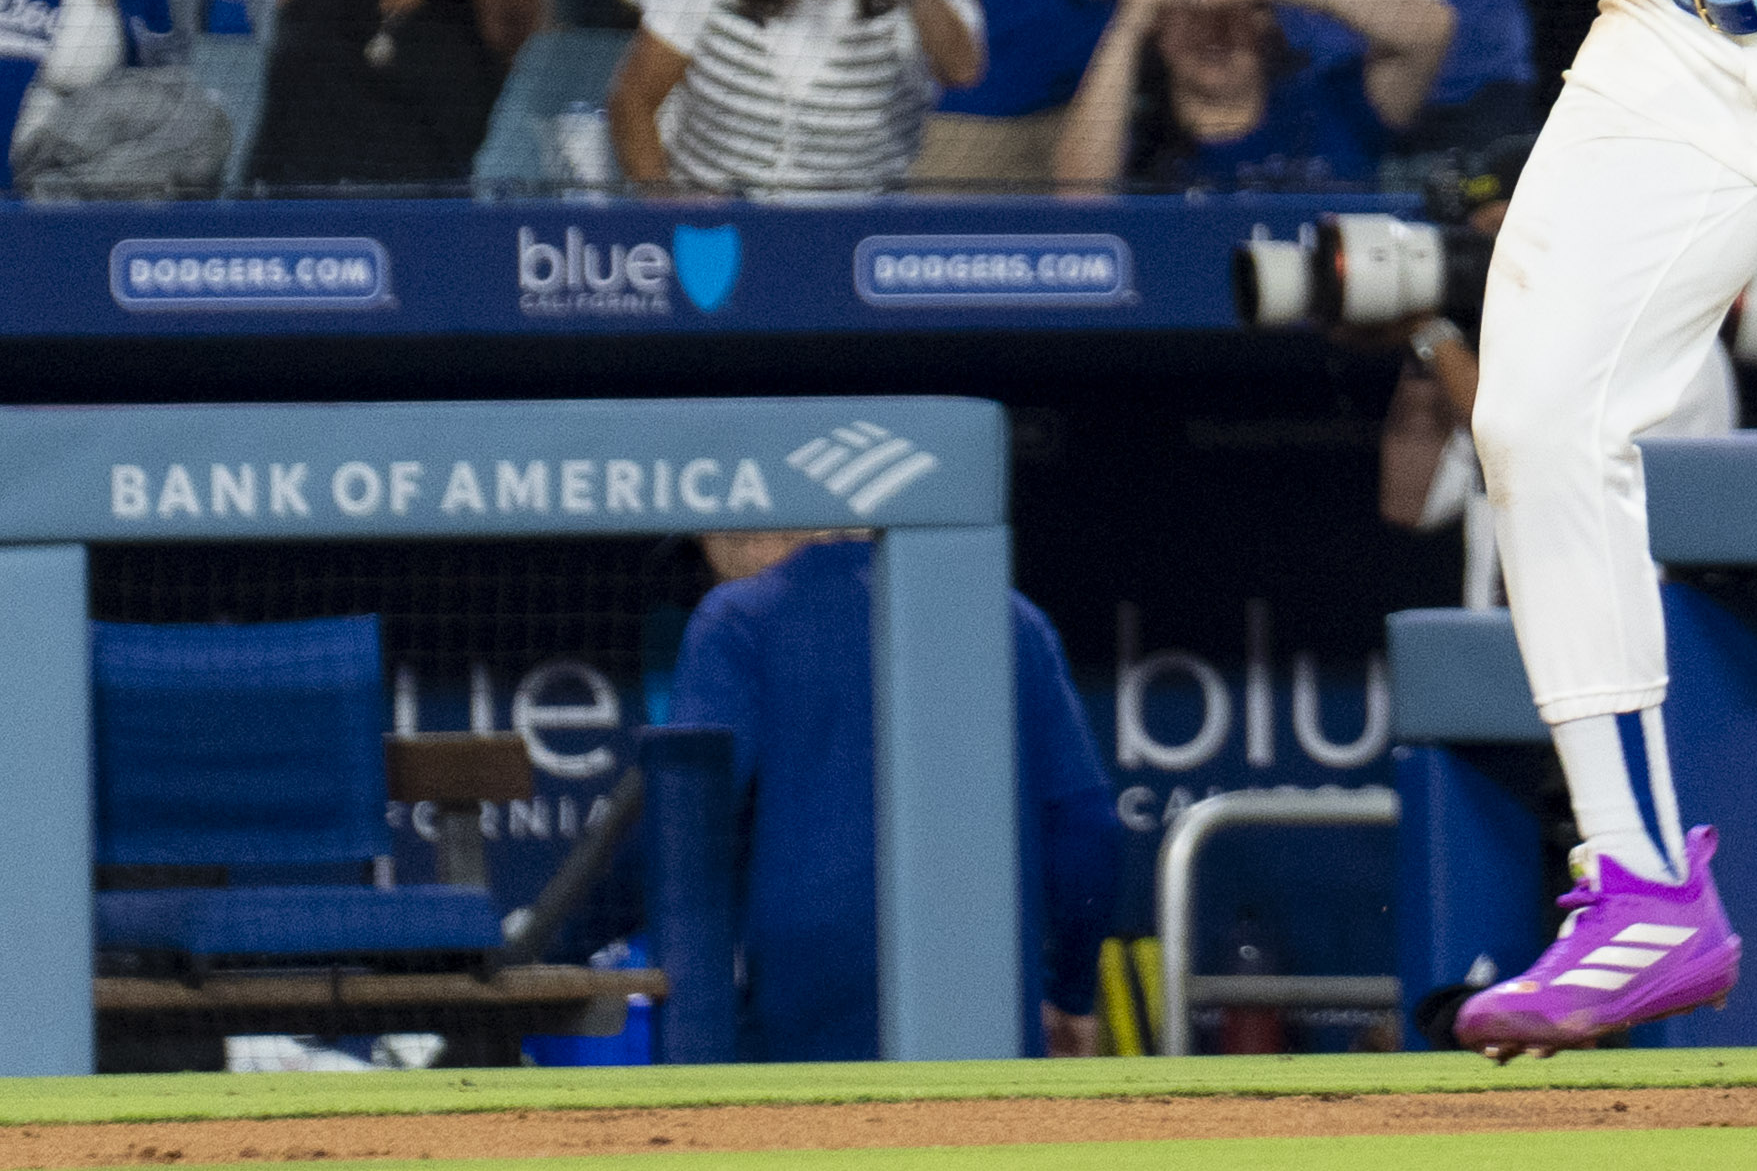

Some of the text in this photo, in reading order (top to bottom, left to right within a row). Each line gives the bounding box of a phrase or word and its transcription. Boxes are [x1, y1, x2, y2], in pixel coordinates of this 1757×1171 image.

[129, 257, 372, 290] DODGERS.COM
[517, 225, 671, 292] blue
[874, 253, 1113, 288] DODGERS.COM
[111, 457, 772, 518] BANK OF AMERICA
[1116, 596, 1392, 770] blu
